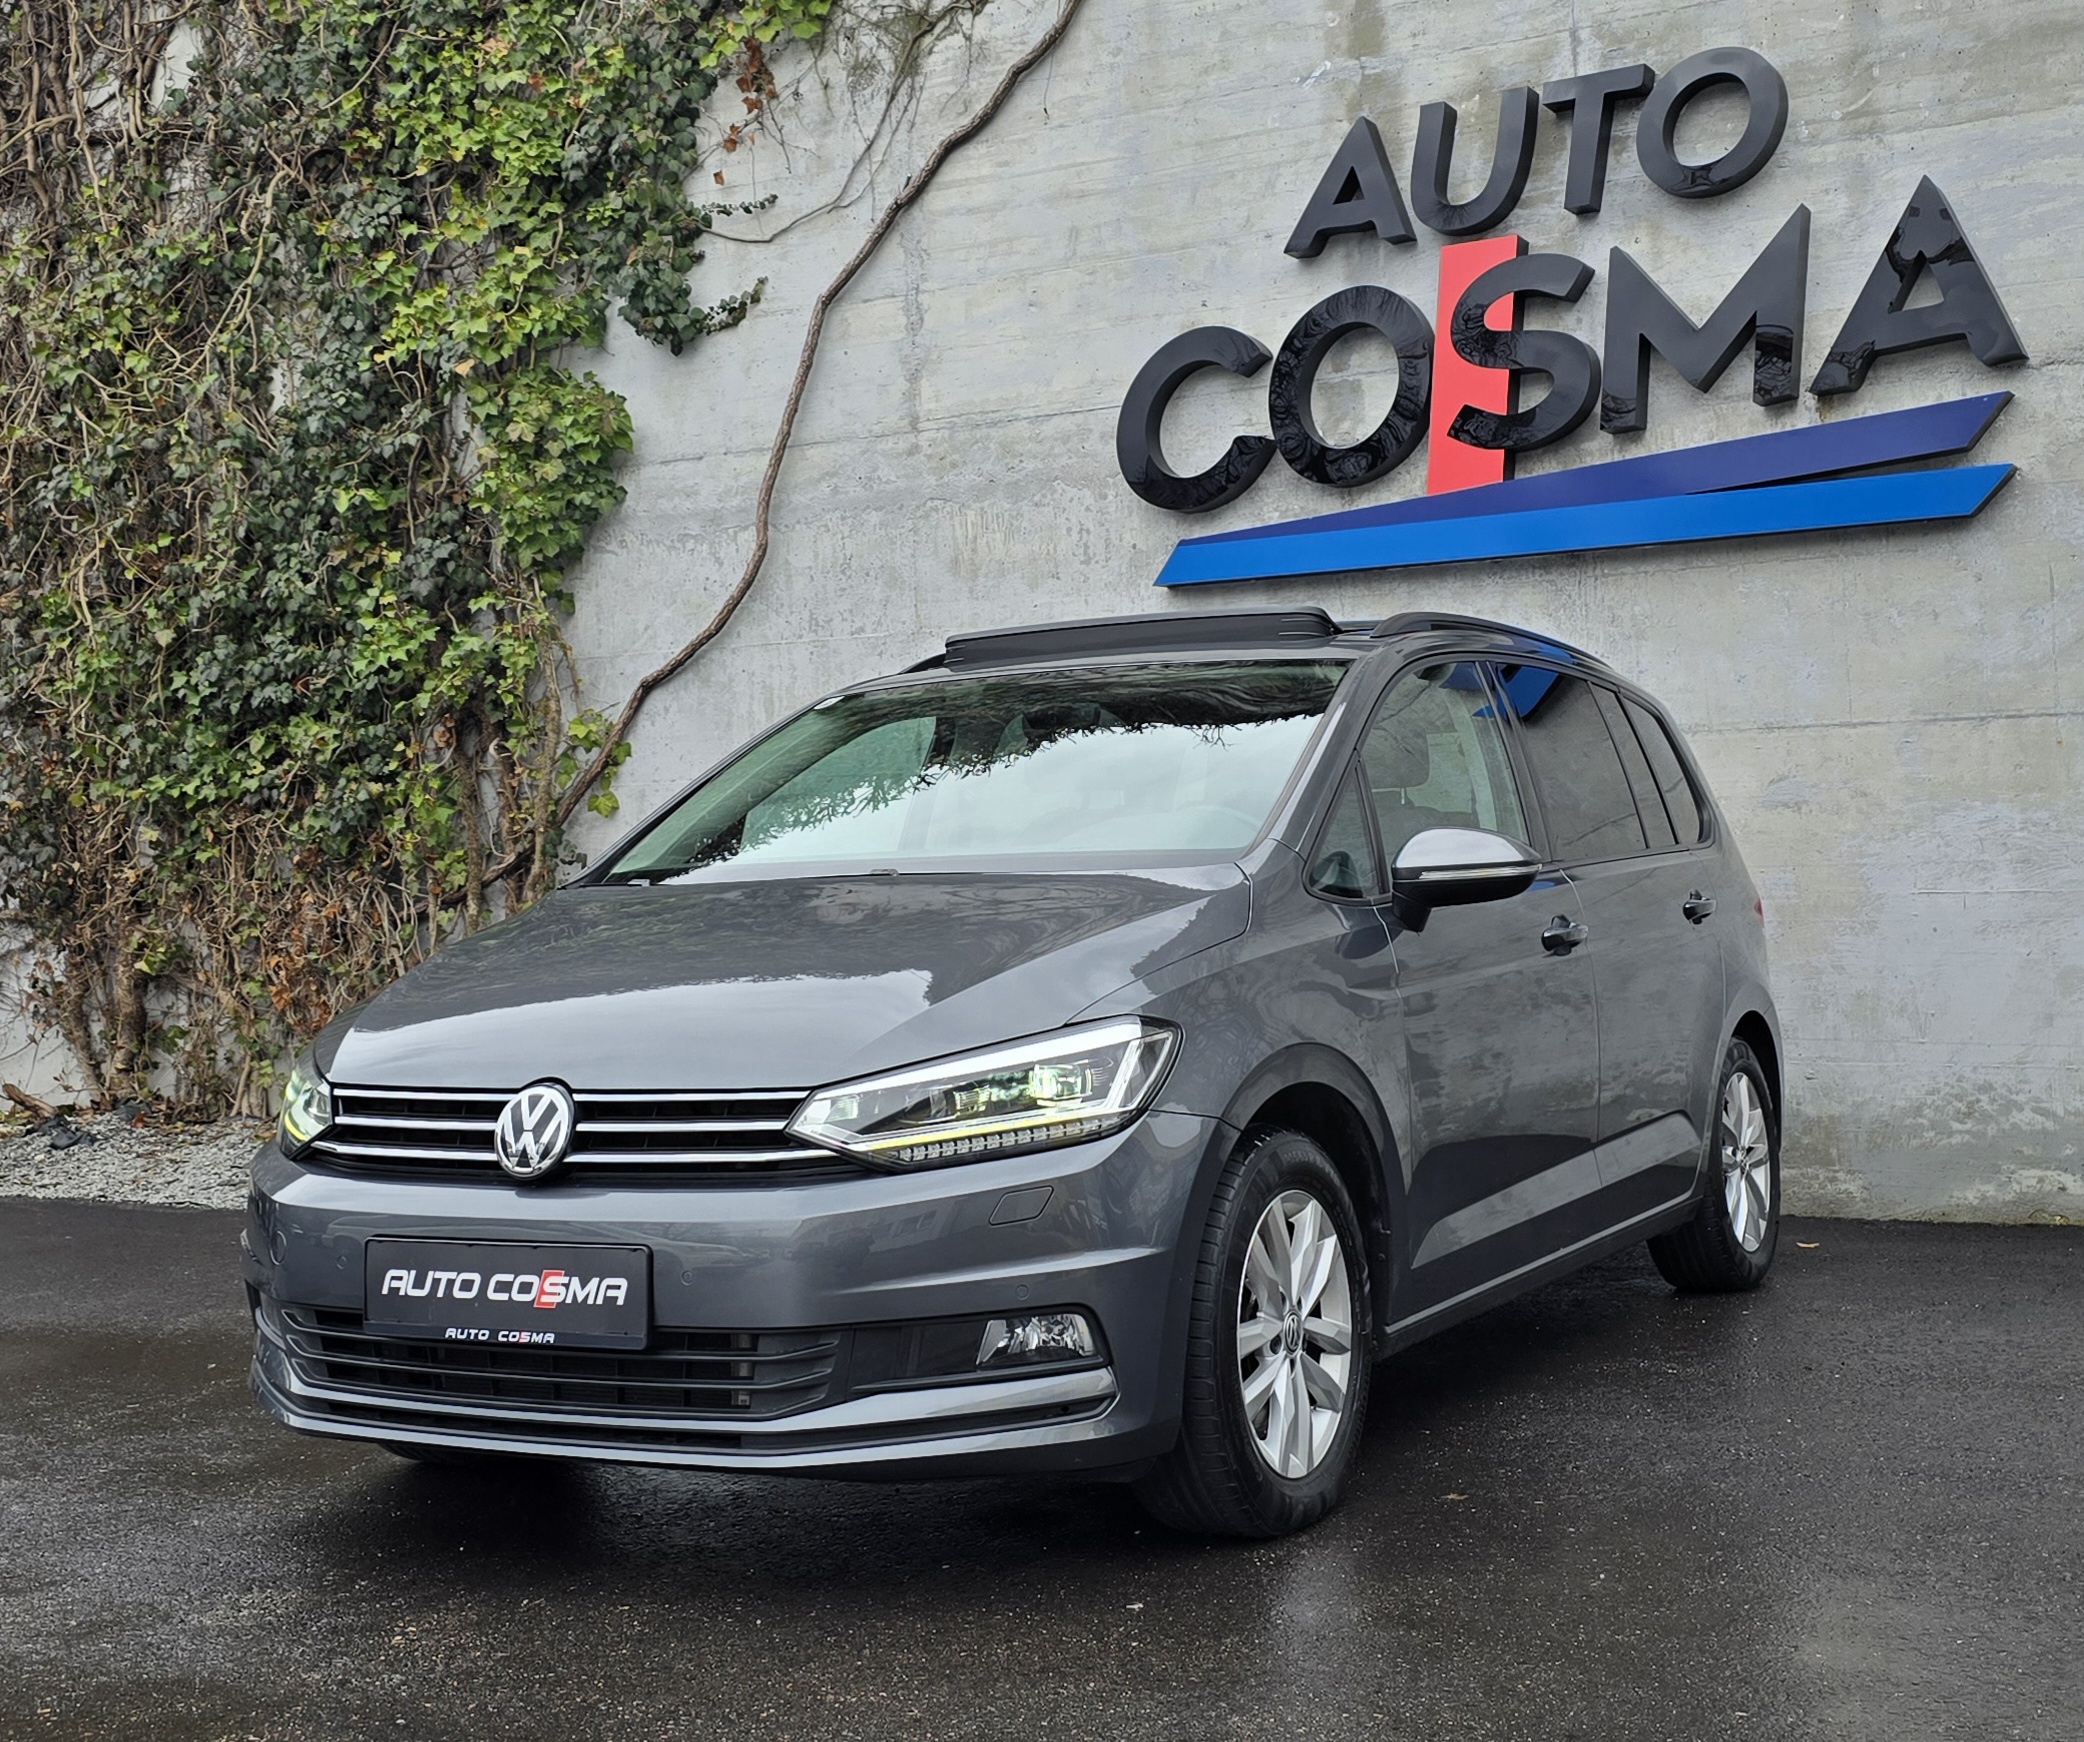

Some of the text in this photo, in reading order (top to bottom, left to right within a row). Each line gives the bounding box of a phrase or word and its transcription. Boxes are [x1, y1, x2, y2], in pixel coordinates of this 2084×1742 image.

[1284, 46, 1788, 260] AUTO
[1116, 174, 2030, 514] COSMA
[381, 1269, 628, 1306] AUTO COSMA
[445, 1327, 555, 1344] AUTO COSMA
